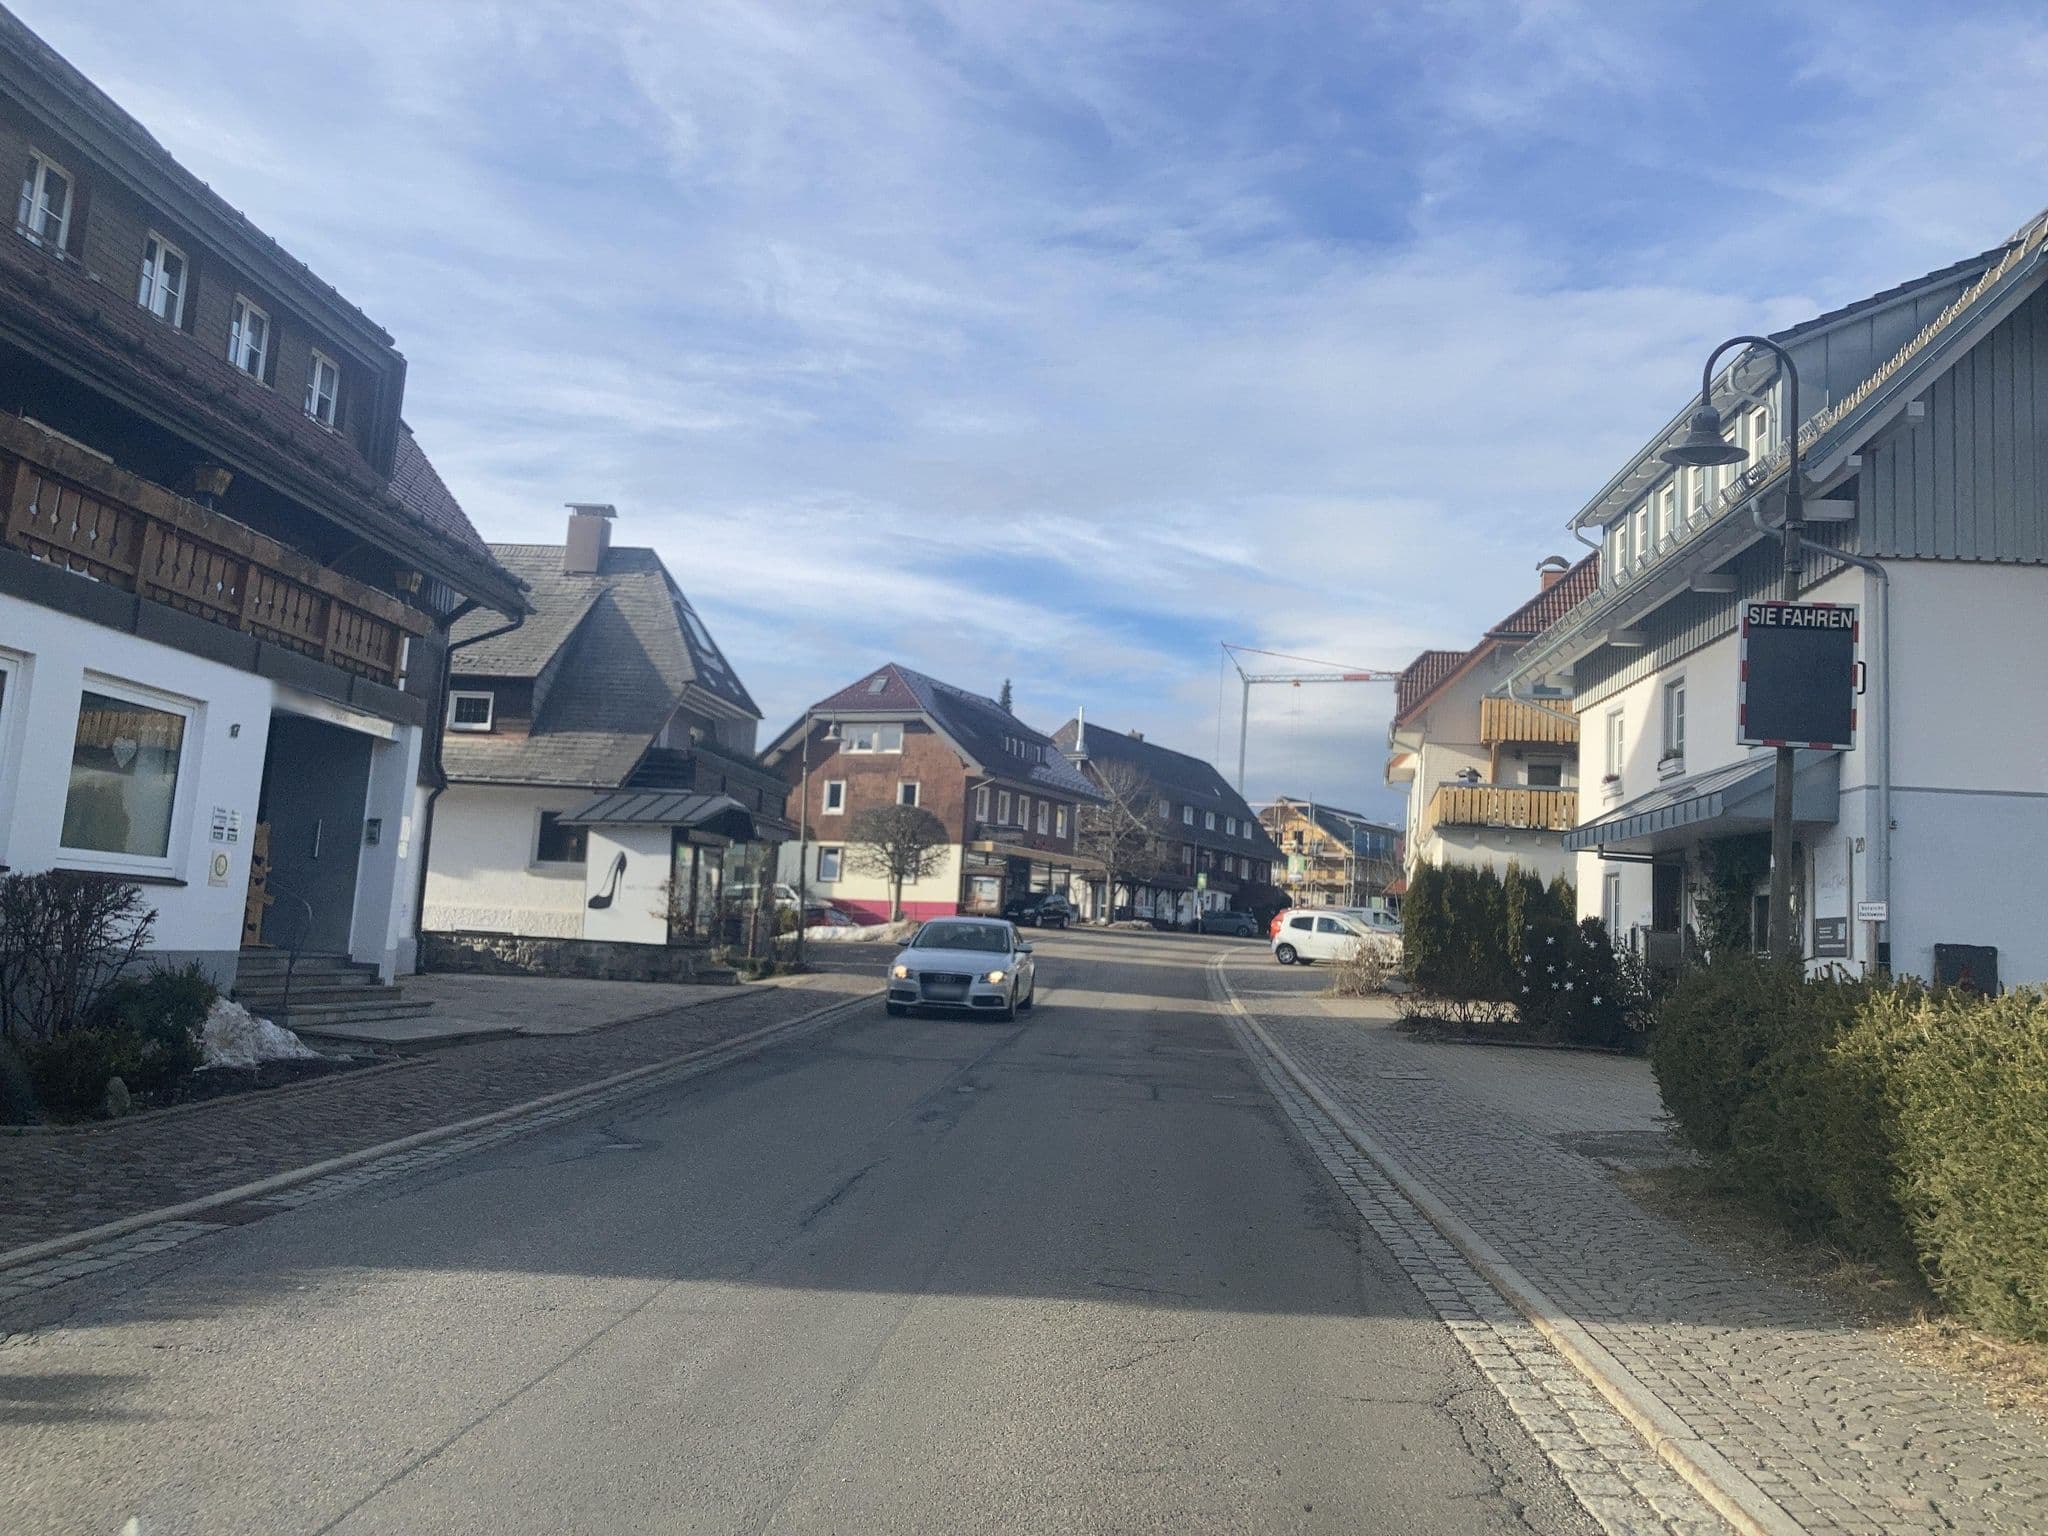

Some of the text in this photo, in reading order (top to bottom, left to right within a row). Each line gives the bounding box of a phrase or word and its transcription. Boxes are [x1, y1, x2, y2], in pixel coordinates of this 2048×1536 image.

[1749, 607, 1853, 629] SIE FAHREN
[1855, 837, 1865, 853] 20
